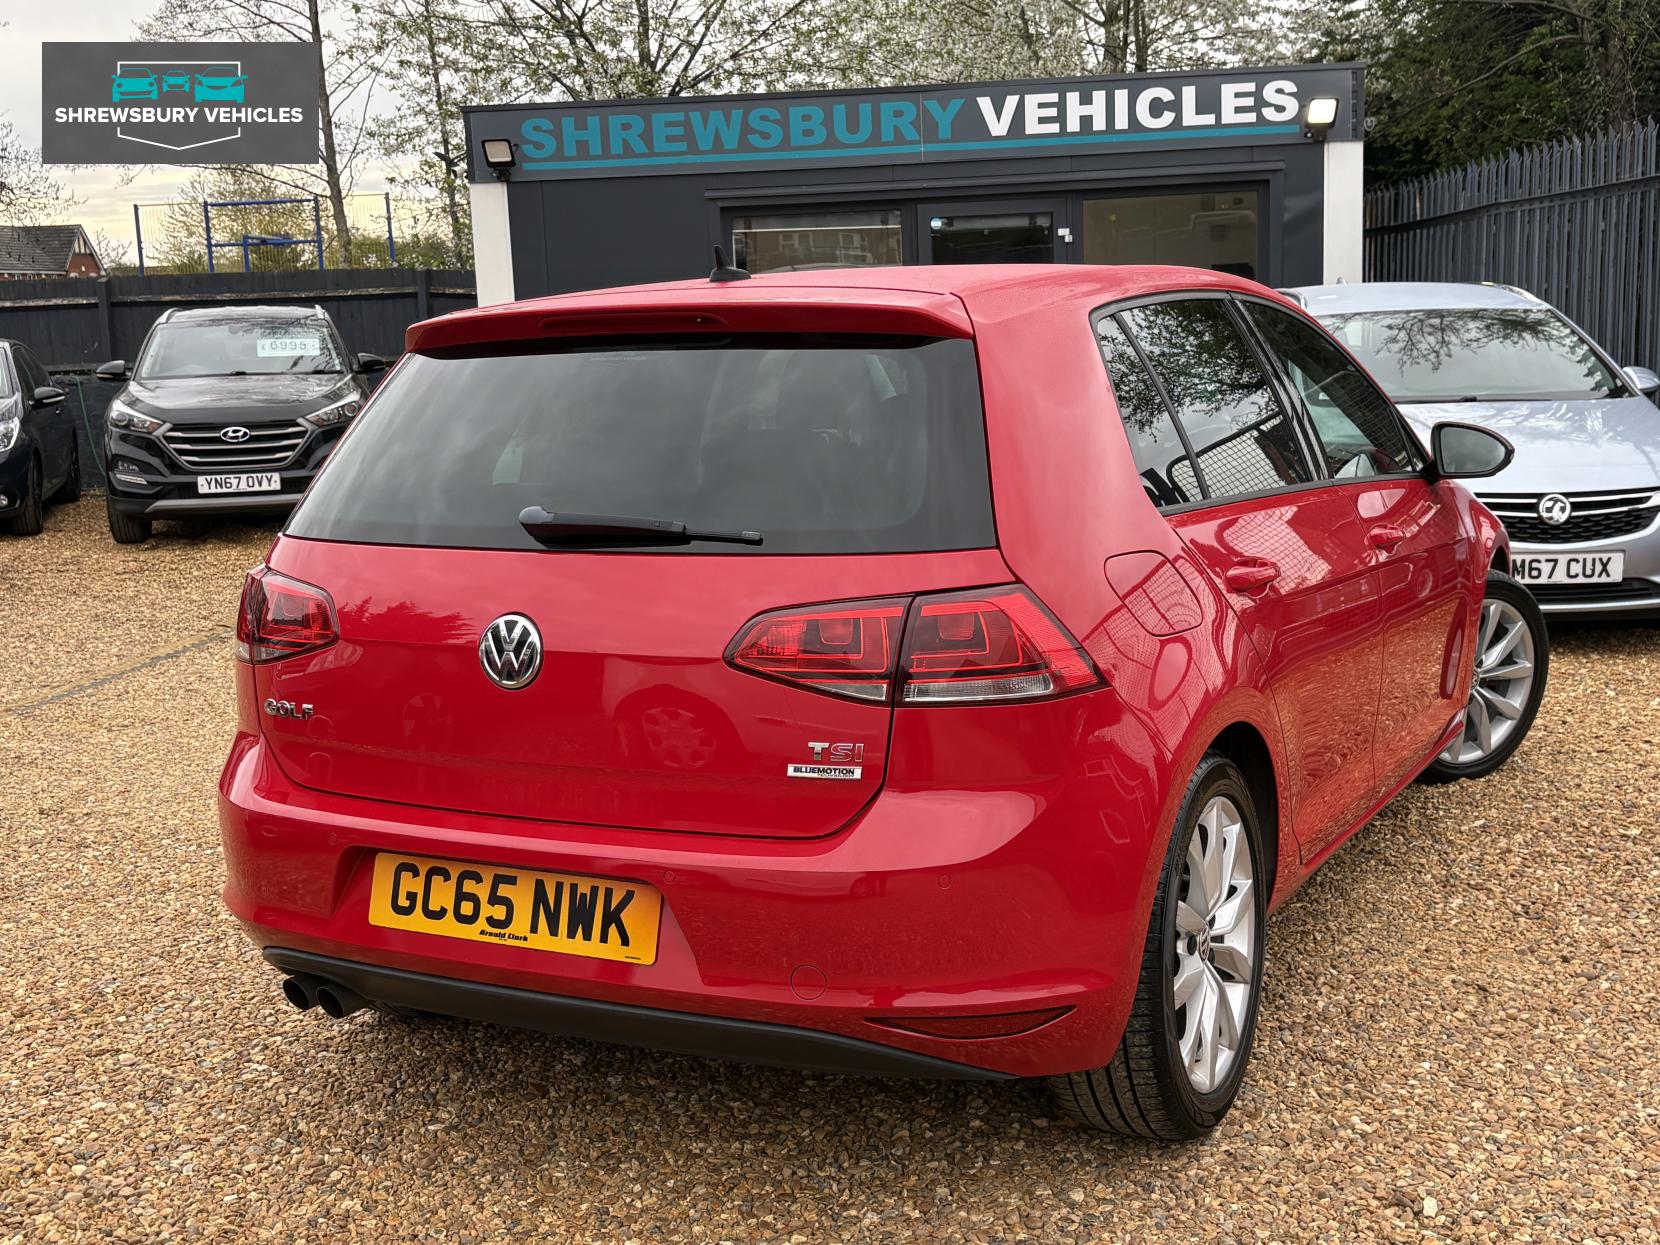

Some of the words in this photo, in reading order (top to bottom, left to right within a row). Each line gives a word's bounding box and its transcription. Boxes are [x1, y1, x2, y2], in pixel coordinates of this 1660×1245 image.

[520, 98, 966, 158] SHREWSBURY
[976, 79, 1300, 137] VEHICLES
[204, 476, 242, 490] YN67
[246, 474, 273, 488] OVY
[1566, 557, 1612, 579] CUX
[263, 698, 314, 720] GOLF
[807, 741, 864, 762] TSI
[793, 765, 855, 775] BLUEMOTION
[390, 861, 518, 930] GC65
[529, 878, 636, 947] NWK
